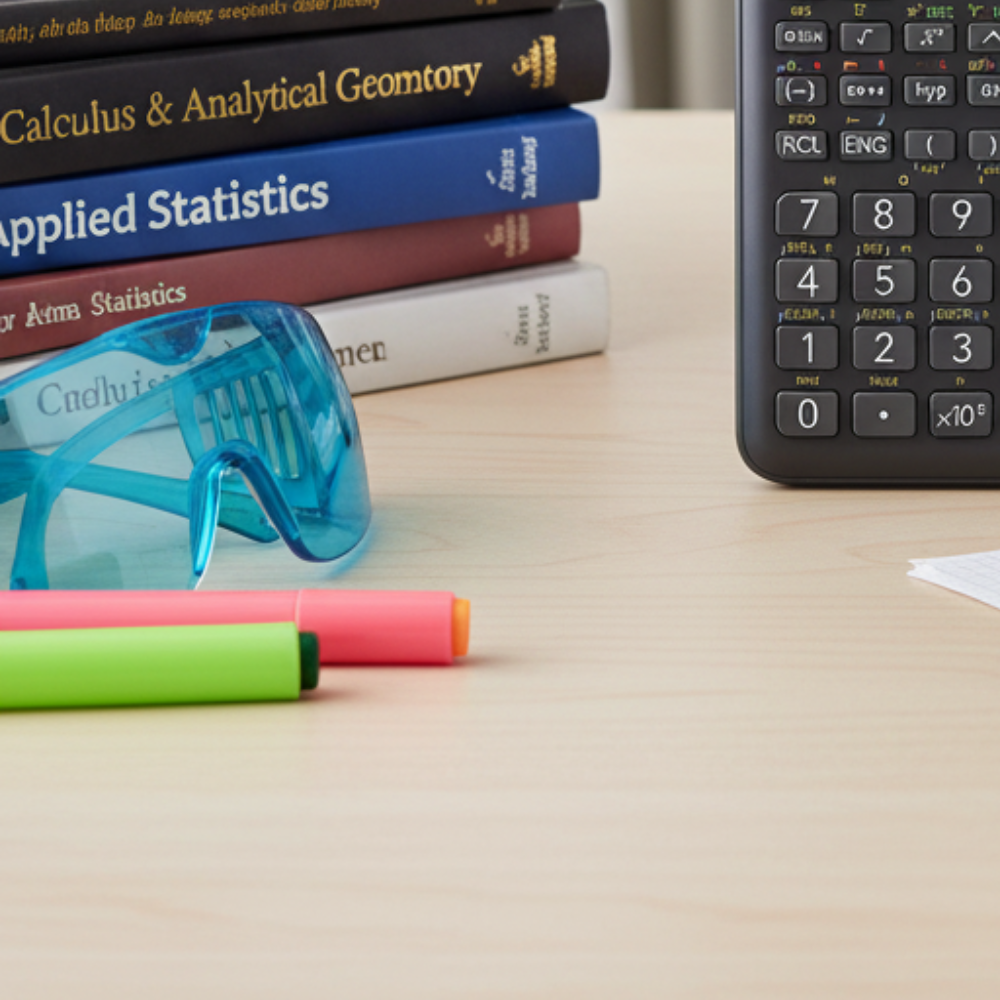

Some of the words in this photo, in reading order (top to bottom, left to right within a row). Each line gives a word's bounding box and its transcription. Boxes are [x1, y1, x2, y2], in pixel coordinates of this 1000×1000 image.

[0, 100, 136, 146] Calculus
[146, 91, 173, 127] &
[182, 70, 328, 124] Analytical
[335, 62, 483, 102] Geomtory
[782, 136, 822, 155] RCL
[844, 135, 887, 154] ENG
[148, 174, 329, 230] Statistics
[800, 198, 820, 231] 7
[873, 198, 894, 230] 8
[952, 198, 973, 231] 9
[796, 264, 820, 299] 4
[874, 264, 895, 297] 5
[952, 264, 973, 298] 6
[801, 331, 814, 364] 1
[873, 331, 895, 364] 2
[952, 332, 973, 364] 3
[798, 397, 819, 429] 0
